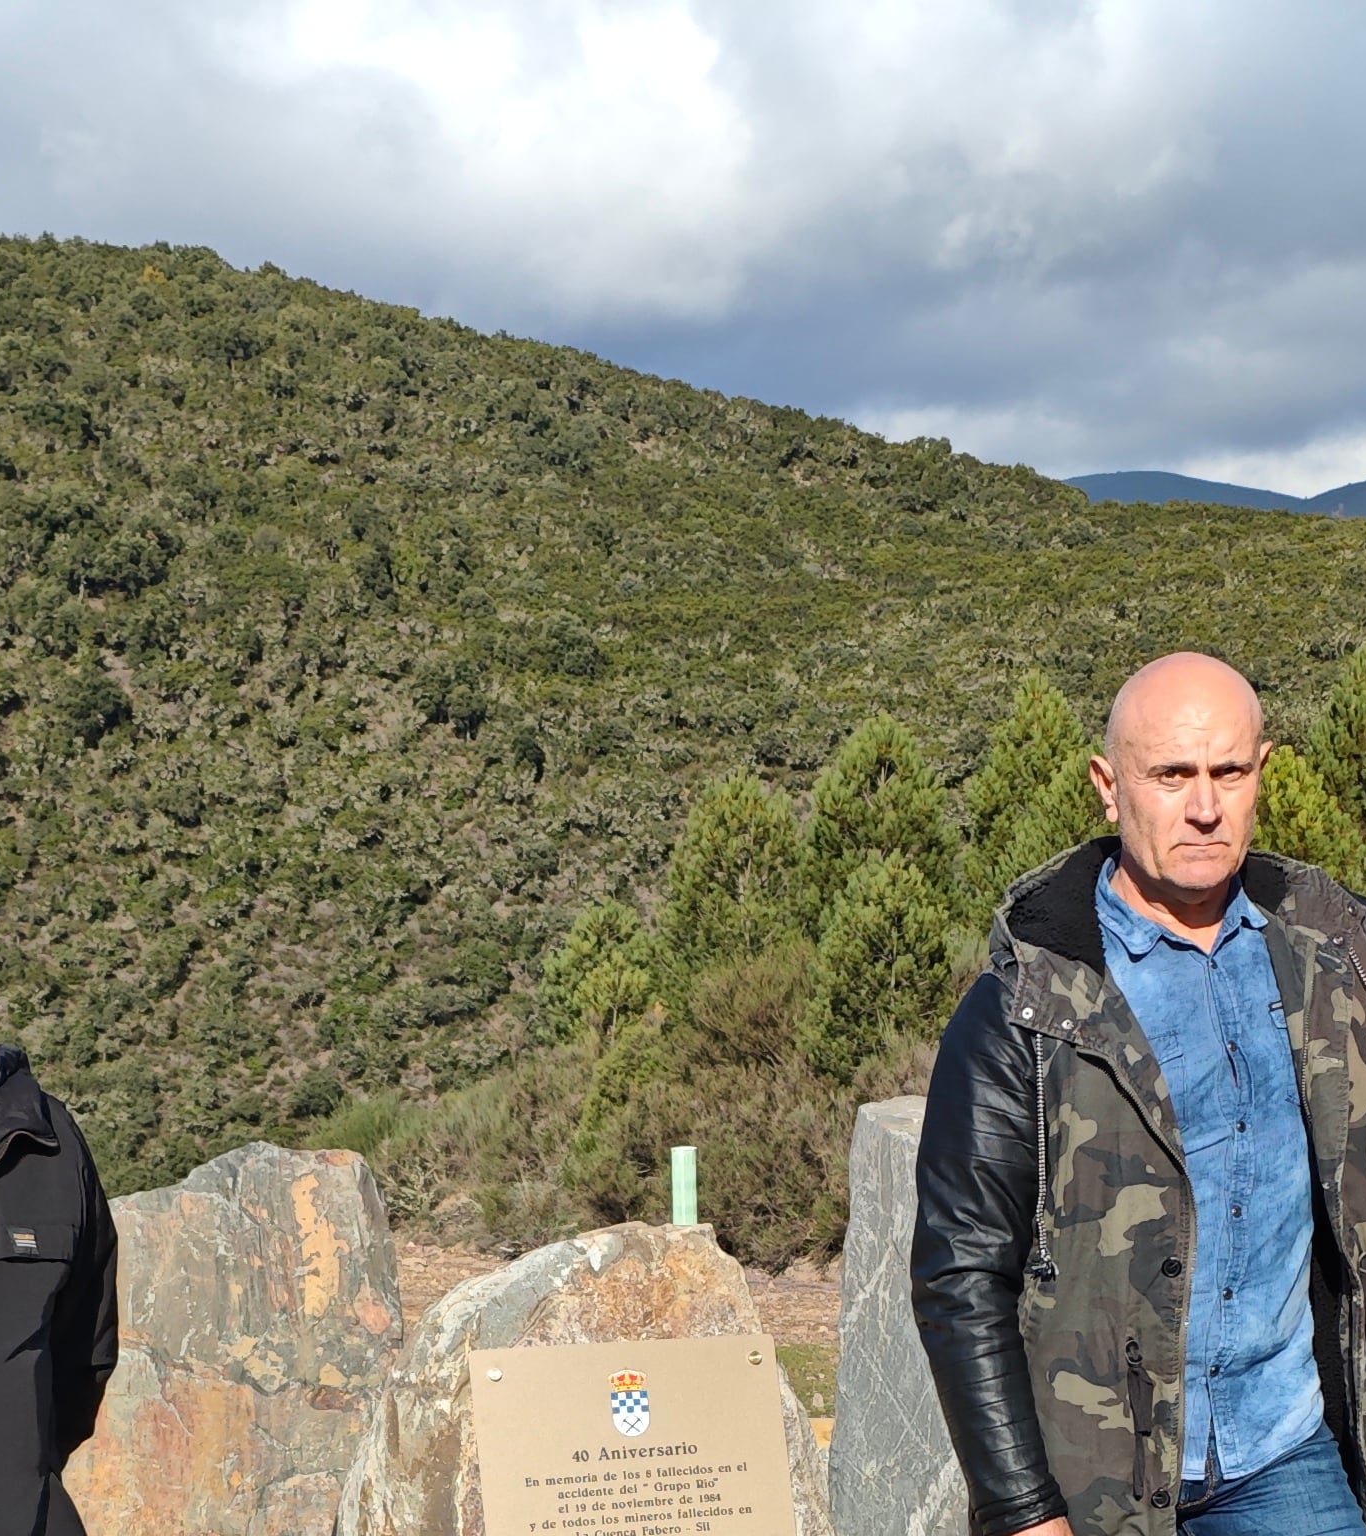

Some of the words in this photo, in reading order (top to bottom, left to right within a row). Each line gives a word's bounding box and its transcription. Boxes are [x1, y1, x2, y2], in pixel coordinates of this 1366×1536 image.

[571, 1449, 590, 1463] 40
[598, 1441, 698, 1461] Aniversario
[525, 1477, 540, 1488] En
[545, 1472, 598, 1487] memoria
[603, 1471, 618, 1482] de
[622, 1470, 641, 1481] los
[645, 1469, 652, 1478] 8
[656, 1464, 714, 1478] fallecidos
[718, 1464, 732, 1473] en
[736, 1461, 748, 1472] el
[557, 1487, 614, 1500] accidente
[619, 1483, 638, 1496] del
[654, 1481, 691, 1493] Grupo
[558, 1505, 569, 1514] el
[575, 1503, 587, 1513] 19
[591, 1501, 606, 1511] de
[611, 1496, 674, 1510] noviembre
[679, 1494, 693, 1505] de
[699, 1493, 721, 1503] 1984
[529, 1522, 537, 1532] y
[541, 1520, 556, 1530] de
[562, 1517, 596, 1528] todos
[601, 1514, 620, 1525] los
[624, 1511, 673, 1523] mineros
[677, 1506, 734, 1519] fallecidos
[739, 1505, 753, 1514] en
[641, 1525, 682, 1536] Fabero
[695, 1521, 711, 1532] Sil
